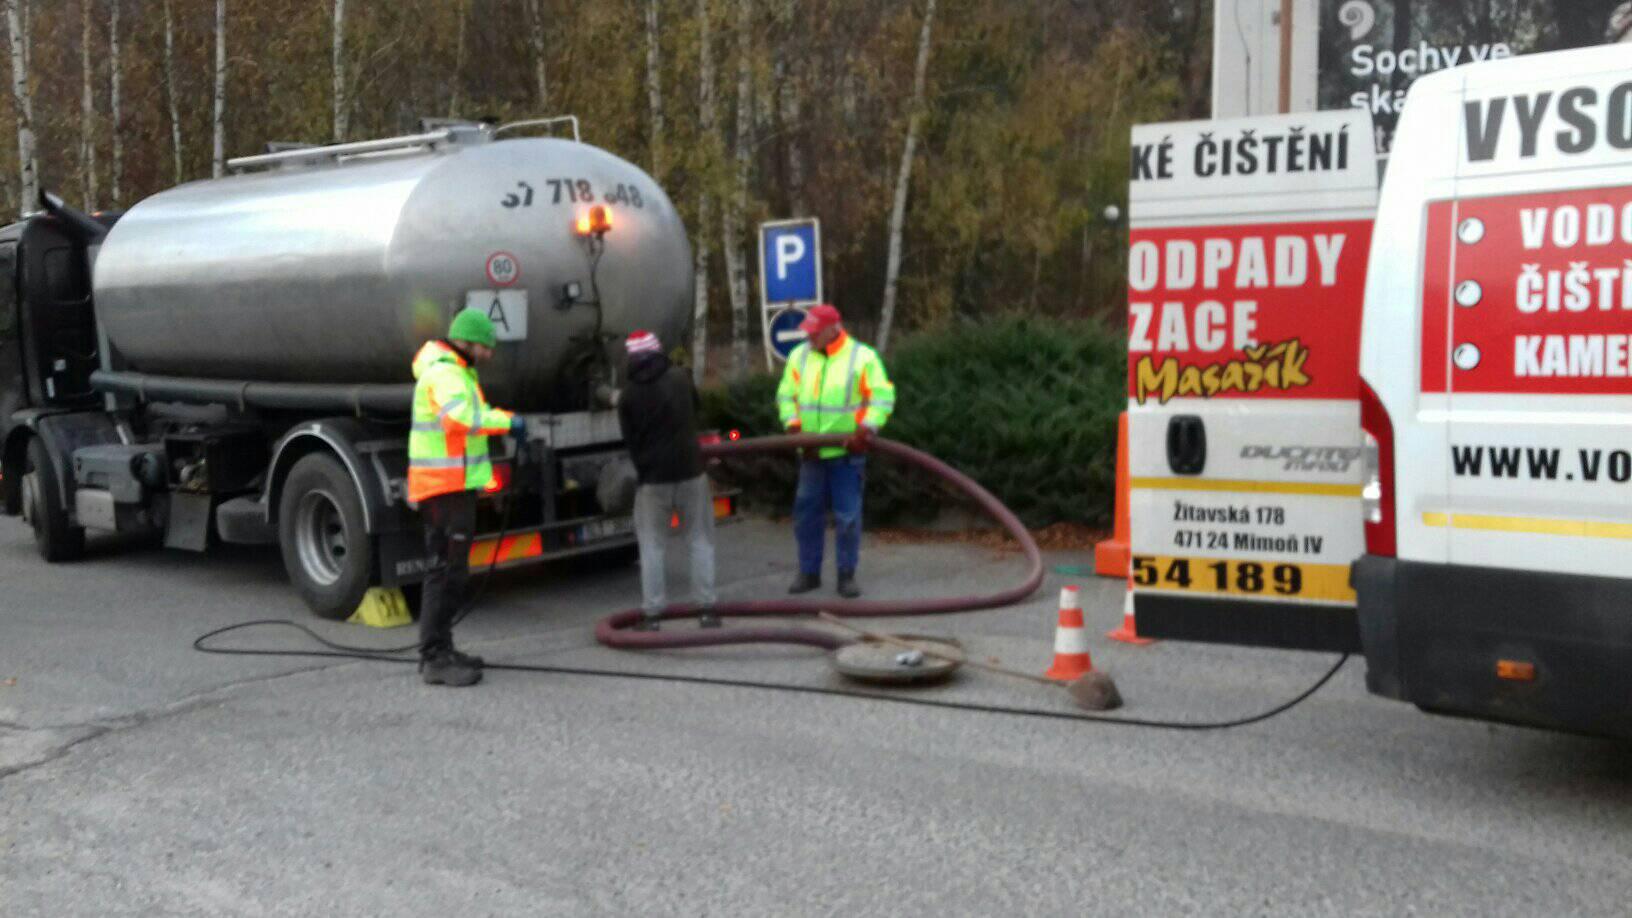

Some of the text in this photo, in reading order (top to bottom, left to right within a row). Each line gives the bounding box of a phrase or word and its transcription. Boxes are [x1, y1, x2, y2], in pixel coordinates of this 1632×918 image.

[1351, 41, 1461, 76] Sochy
[1132, 136, 1173, 181] KÉ
[1194, 123, 1350, 178] ČIŠTĚNÍ
[546, 178, 594, 203] 718
[493, 259, 512, 275] 80
[776, 235, 805, 280] P
[1129, 233, 1346, 291] ODPADY
[488, 298, 510, 332] A
[1129, 300, 1259, 352] ZACE
[1514, 334, 1632, 377] KAME
[1174, 500, 1285, 525] Žitavská 178
[1174, 530, 1323, 554] 471 24 Mimoň IV
[1133, 556, 1303, 595] 54 189
